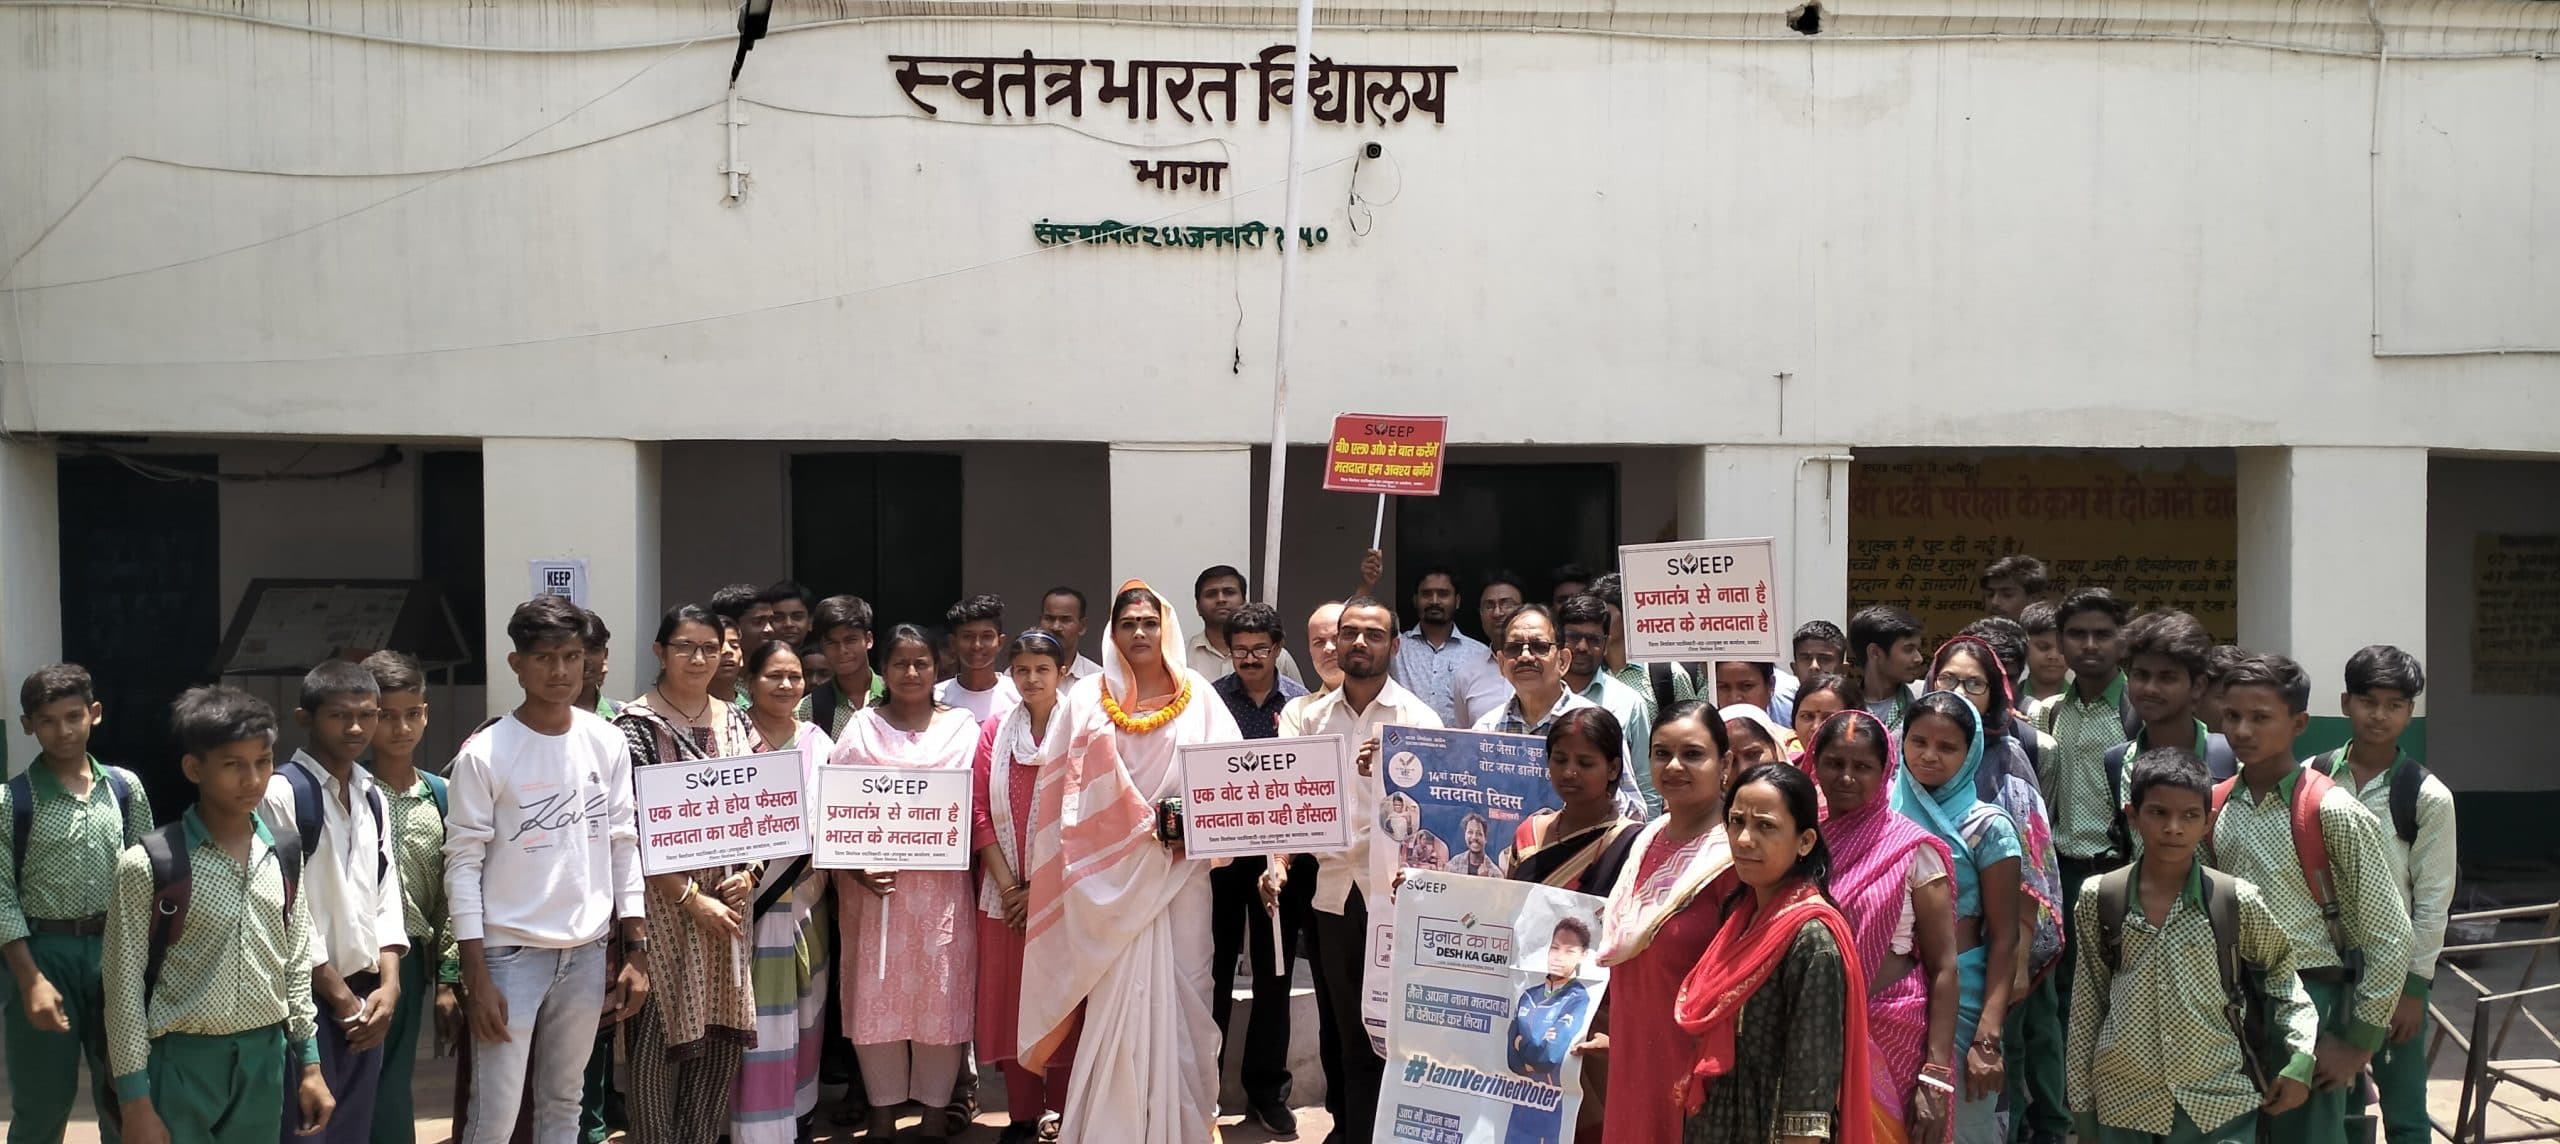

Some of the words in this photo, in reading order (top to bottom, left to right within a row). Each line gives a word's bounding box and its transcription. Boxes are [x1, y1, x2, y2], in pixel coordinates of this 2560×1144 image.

[888, 49, 1086, 117] स्वतंत्र
[1090, 59, 1247, 122] भारत
[1250, 44, 1459, 125] विद्यालय
[1130, 160, 1228, 191] भागा
[1184, 221, 1279, 249] जनवरी
[1275, 225, 1328, 249] १५०
[1364, 423, 1415, 438] SWEEP
[1388, 441, 1398, 457] से
[1334, 460, 1367, 475] मतदाता
[1368, 463, 1384, 476] हम
[1384, 463, 1411, 478] अवश्य
[1667, 552, 1734, 576] SWEEP
[547, 571, 571, 586] KEEP
[1634, 584, 1689, 610] प्रजातंत्र
[1696, 583, 1711, 604] से
[1717, 587, 1750, 604] नाता
[1755, 580, 1766, 604] है
[1636, 617, 1675, 634] भारत
[1679, 611, 1696, 633] के
[1699, 615, 1754, 633] मतदाता
[1757, 608, 1769, 633] है
[1227, 750, 1297, 773] SWEEP
[1496, 740, 1516, 755] जैसा
[1527, 747, 1544, 762] कुछ
[685, 766, 758, 790] SWEEP
[862, 774, 929, 795] SWEEP
[1449, 770, 1478, 787] राष्ट्रीय
[1192, 787, 1215, 804] एक
[1221, 781, 1244, 801] वोट
[1247, 780, 1260, 800] से
[1264, 778, 1289, 801] होय
[1294, 775, 1335, 797] फैसला
[1430, 785, 1483, 804] मतदाता
[1486, 787, 1524, 810] दिवस
[648, 807, 672, 823] एक
[678, 802, 702, 818] वोट
[706, 795, 720, 816] से
[725, 793, 751, 815] होय
[755, 788, 798, 809] फैसला
[826, 802, 881, 822] प्रजातंत्र
[888, 803, 903, 820] से
[908, 806, 942, 821] नाता
[947, 802, 960, 823] है
[1195, 812, 1243, 830] मतदाता
[1247, 811, 1265, 826] का
[1268, 803, 1293, 826] यही
[1296, 802, 1337, 825] हौंसला
[650, 827, 702, 849] मतदाता
[706, 824, 725, 842] का
[728, 816, 754, 840] यही
[757, 814, 801, 838] हौंसला
[825, 829, 862, 846] भारत
[867, 825, 883, 844] के
[886, 830, 943, 846] मतदाता
[946, 826, 959, 846] है
[1406, 878, 1447, 893] SWEEP
[1422, 928, 1463, 949] चुनाव
[1466, 934, 1488, 949] का
[1436, 946, 1464, 960] DESH
[1465, 949, 1479, 961] KA
[1481, 952, 1508, 965] GARV
[1425, 990, 1449, 1004] अपना
[1450, 994, 1469, 1007] नाम
[1471, 998, 1500, 1011] मतदाता
[1447, 1014, 1461, 1026] कर
[1404, 1054, 1562, 1108] #IamVerifiedVoter
